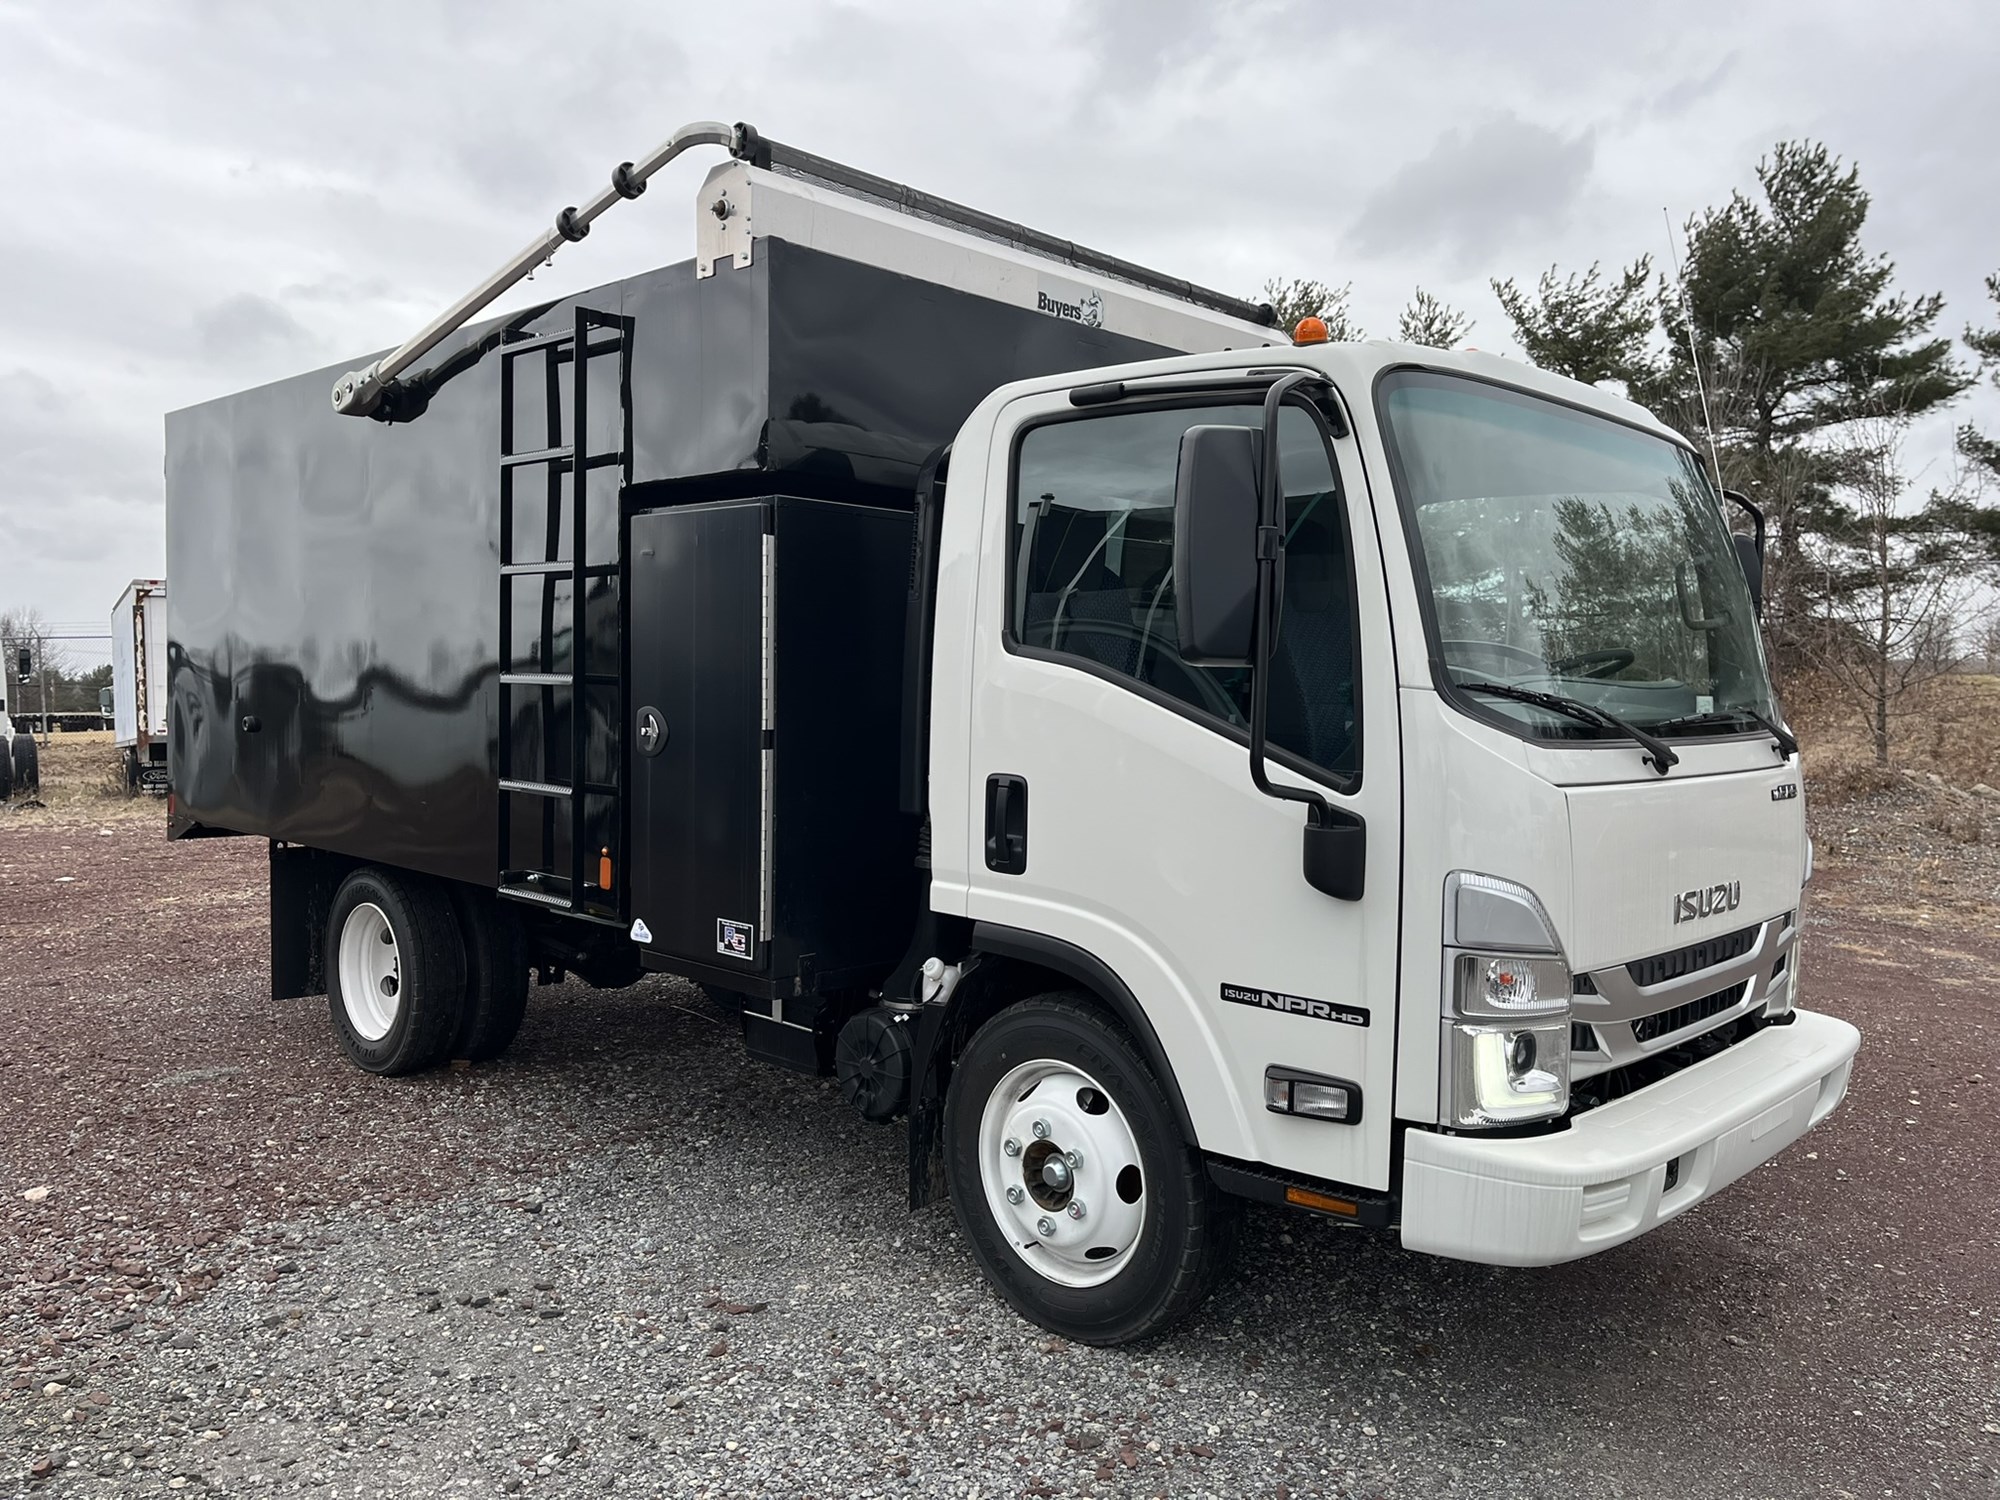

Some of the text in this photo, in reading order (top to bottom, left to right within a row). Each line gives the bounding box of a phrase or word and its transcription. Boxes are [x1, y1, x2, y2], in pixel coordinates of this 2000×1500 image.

[1037, 291, 1082, 320] Buyers
[1673, 880, 1741, 925] ISUZU
[1225, 988, 1364, 1024] ISUZU NPR HD
